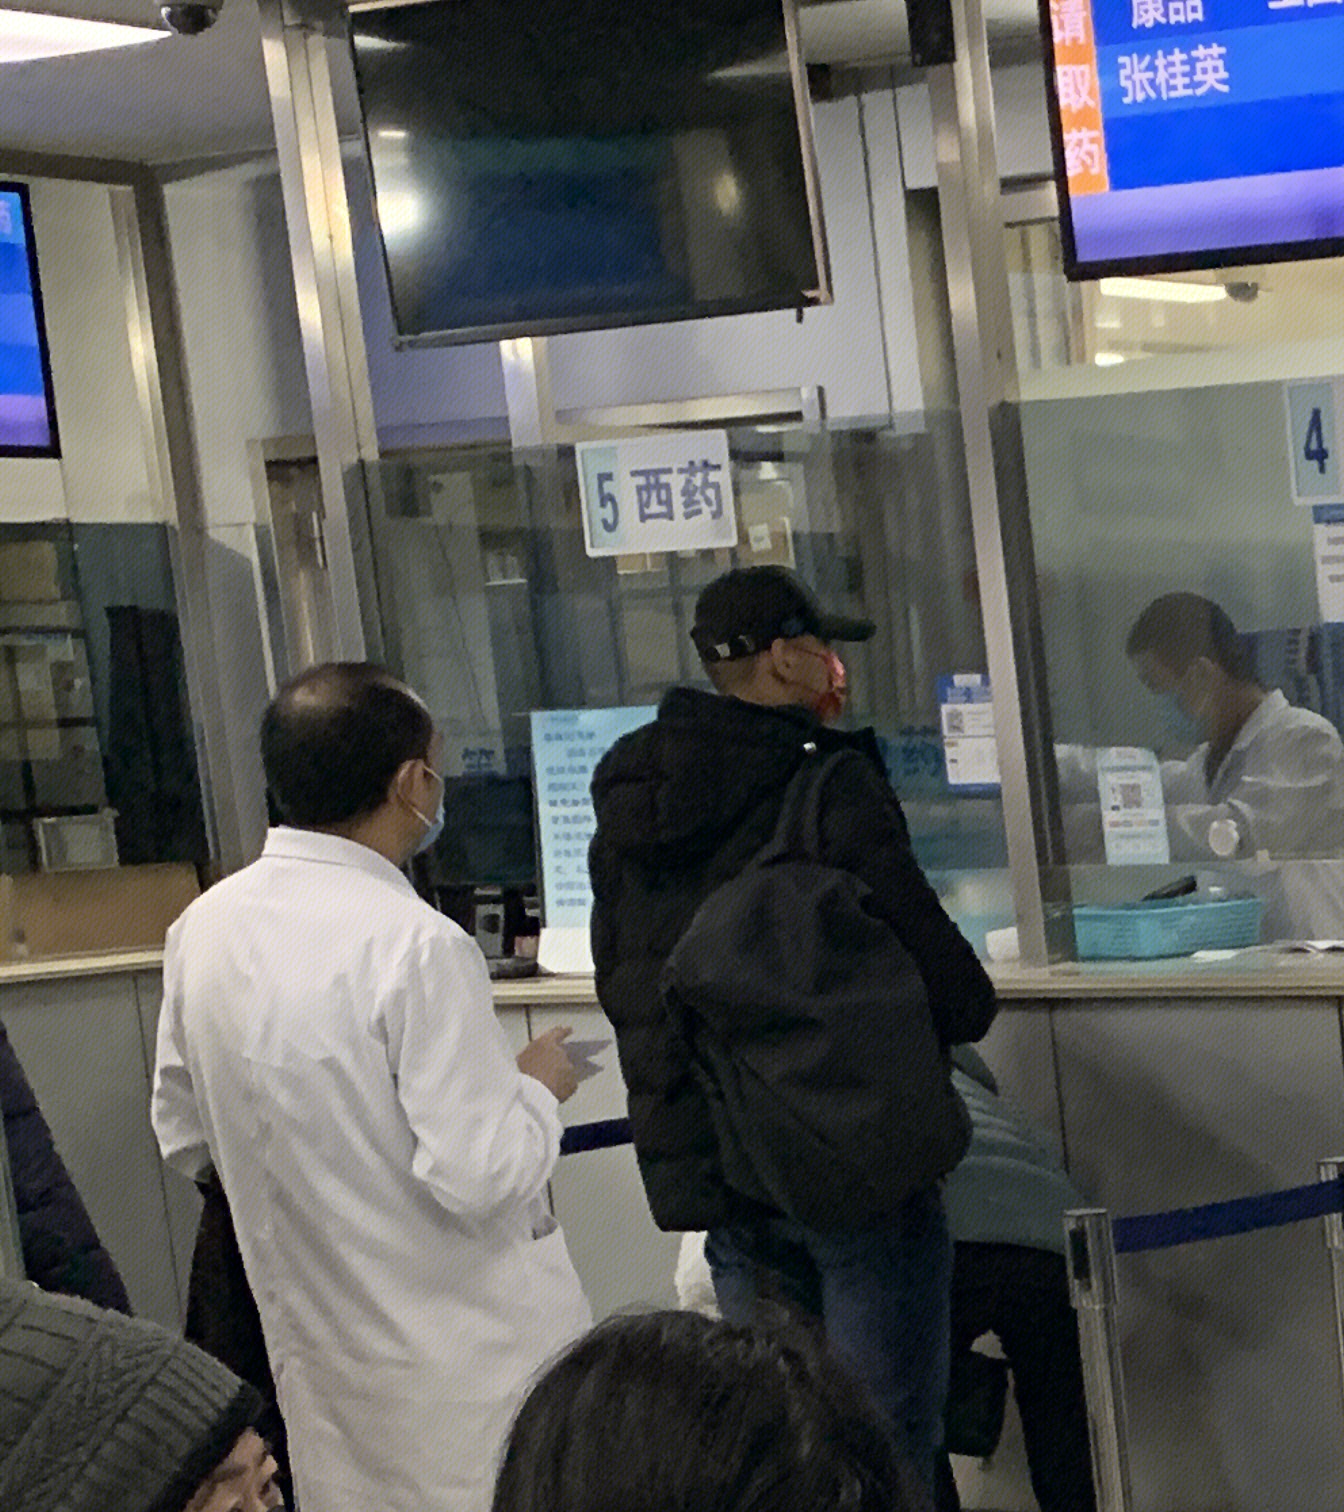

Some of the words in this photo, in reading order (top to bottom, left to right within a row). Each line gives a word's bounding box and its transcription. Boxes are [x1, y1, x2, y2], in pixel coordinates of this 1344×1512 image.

[1050, 0, 1102, 176] 请取药
[1117, 43, 1231, 105] 张桂英
[1304, 407, 1329, 475] 4
[594, 471, 619, 533] 5
[629, 460, 723, 524] 西药
